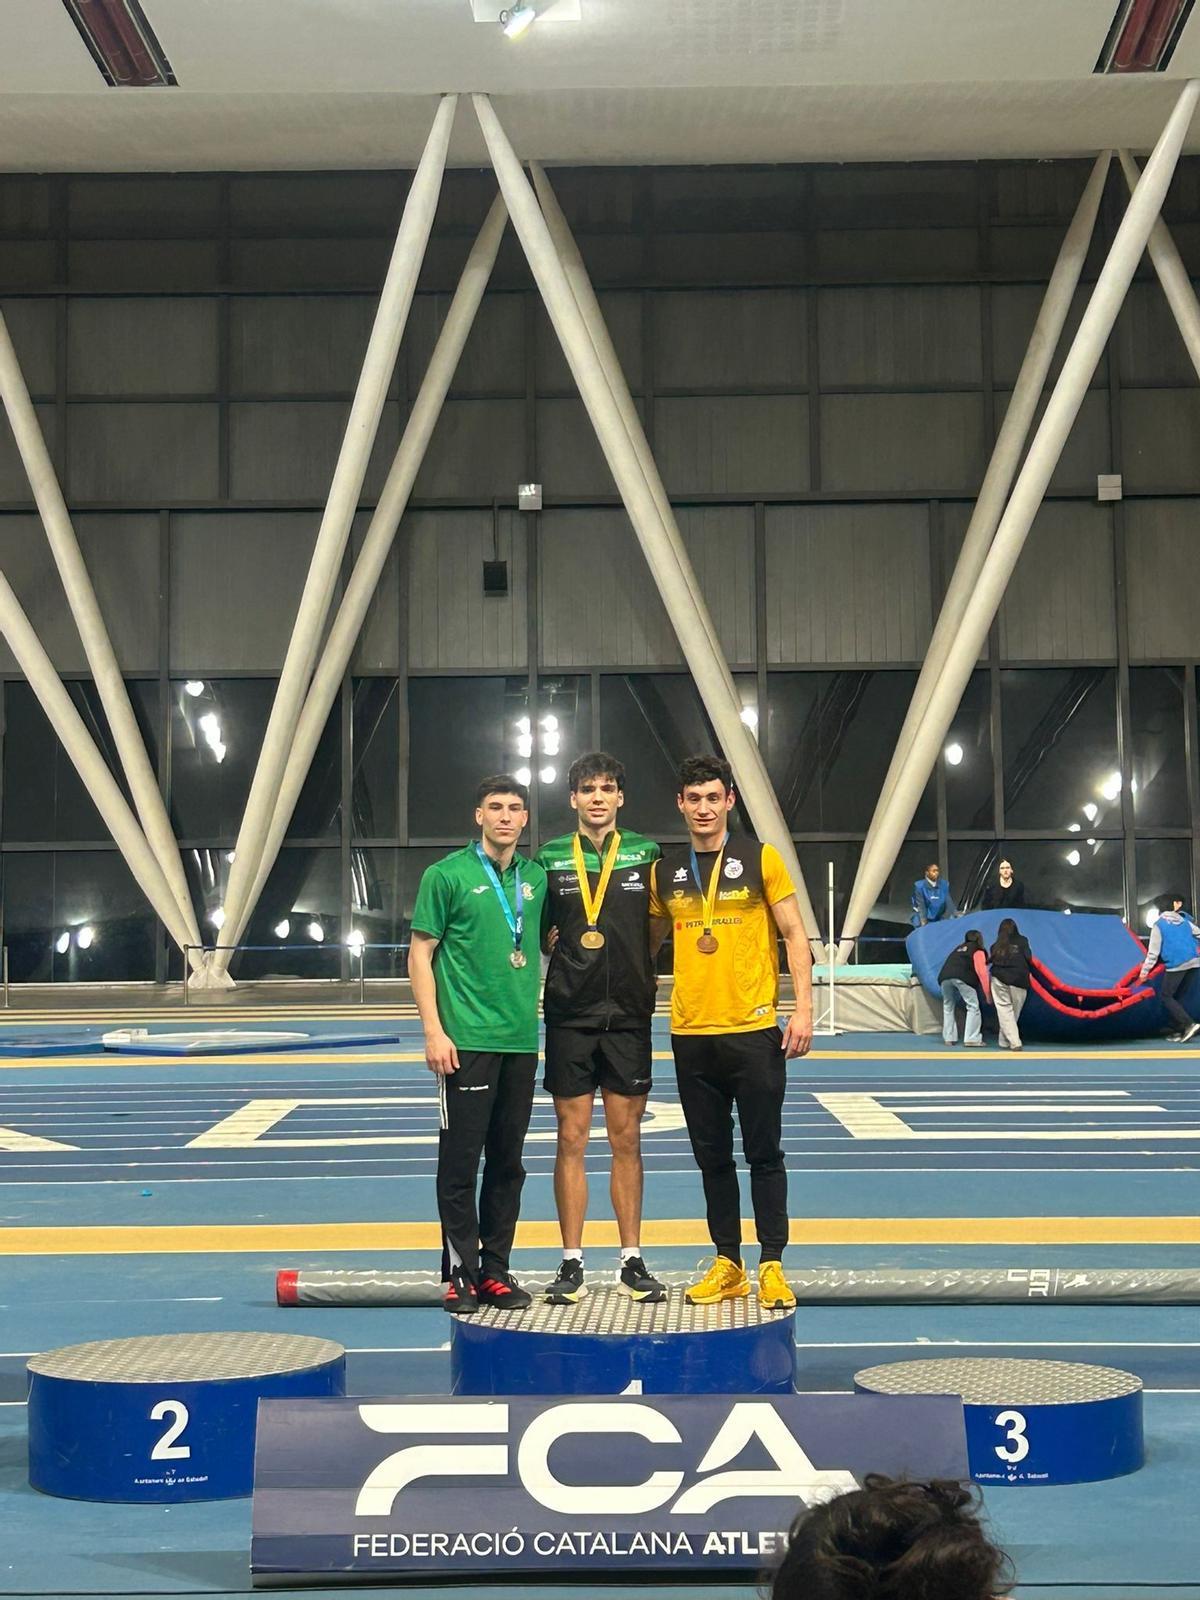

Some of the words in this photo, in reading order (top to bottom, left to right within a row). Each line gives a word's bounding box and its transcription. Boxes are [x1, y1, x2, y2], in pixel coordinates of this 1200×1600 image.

[150, 1400, 191, 1460] 2
[994, 1410, 1029, 1463] 3
[355, 1402, 860, 1516] FCA
[353, 1526, 525, 1557] FEDERACIÓ
[533, 1531, 694, 1556] CATALANA
